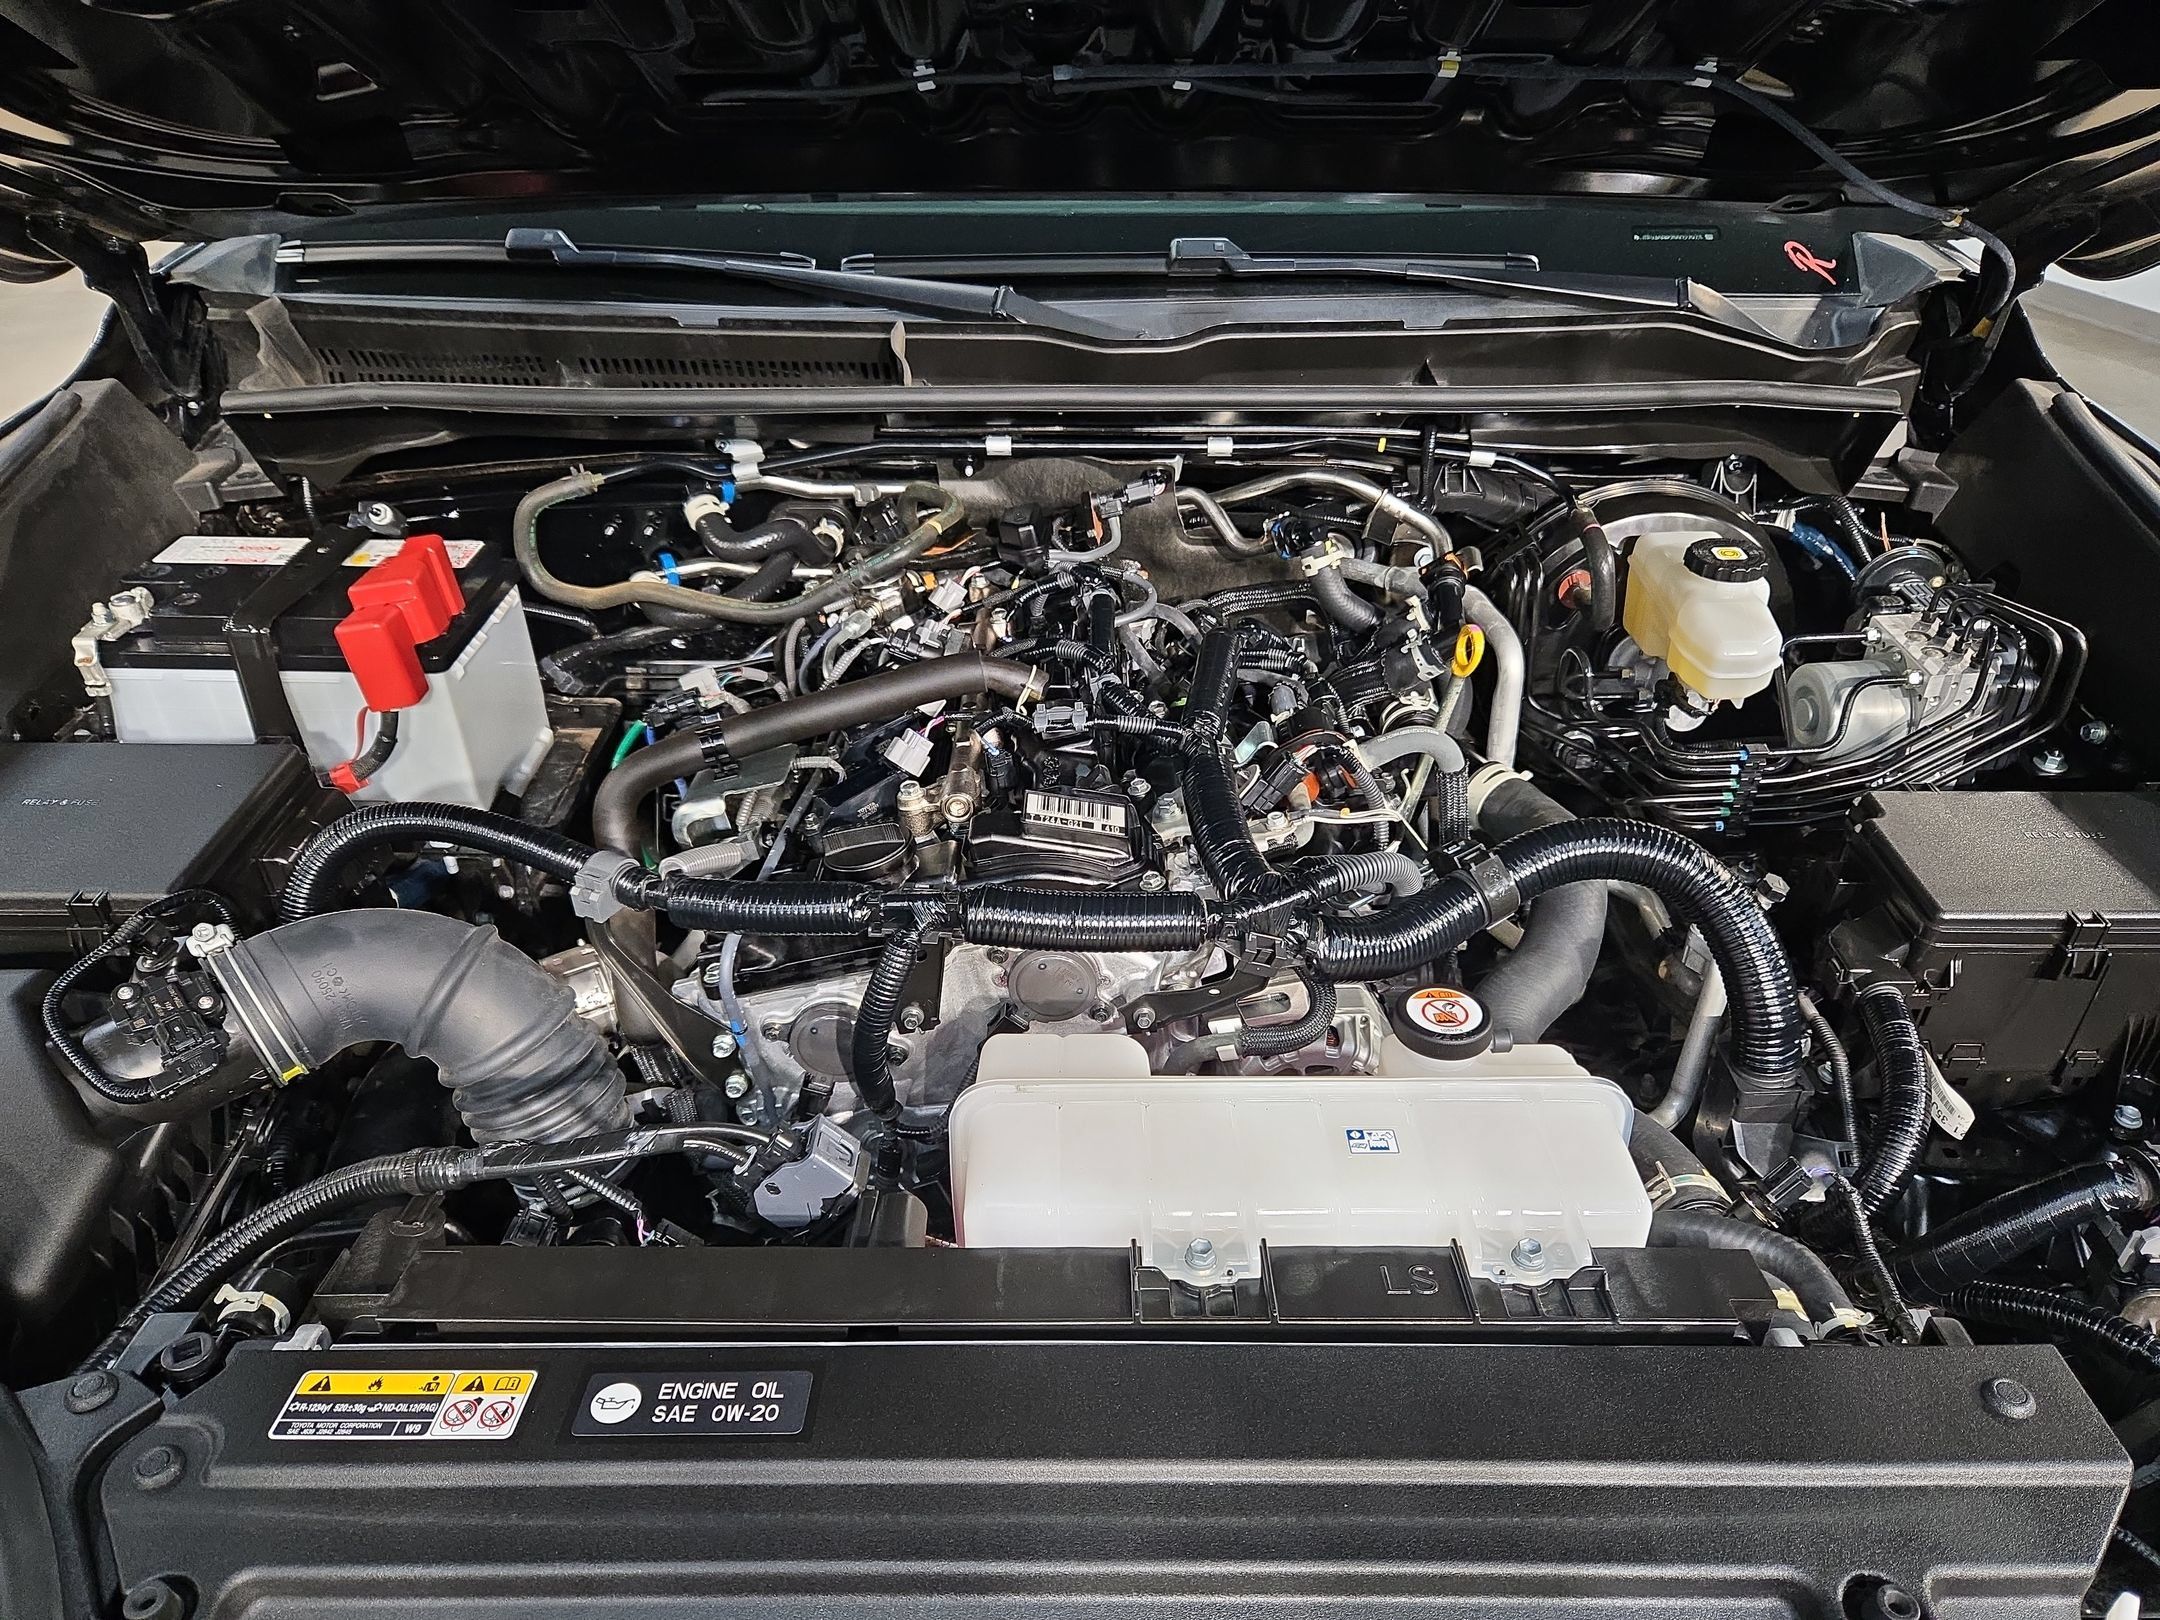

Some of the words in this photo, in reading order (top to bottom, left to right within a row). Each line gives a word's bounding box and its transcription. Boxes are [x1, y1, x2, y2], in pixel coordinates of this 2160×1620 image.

[2023, 831, 2061, 839] RELAY
[1379, 1264, 1439, 1295] LS
[657, 1382, 739, 1400] ENGINE
[751, 1381, 785, 1399] OIL
[298, 1402, 332, 1414] R-1234yf
[333, 1402, 367, 1414] 520±30g
[651, 1404, 698, 1423] SAE
[711, 1404, 780, 1423] 0W-20
[404, 1423, 422, 1434] W9
